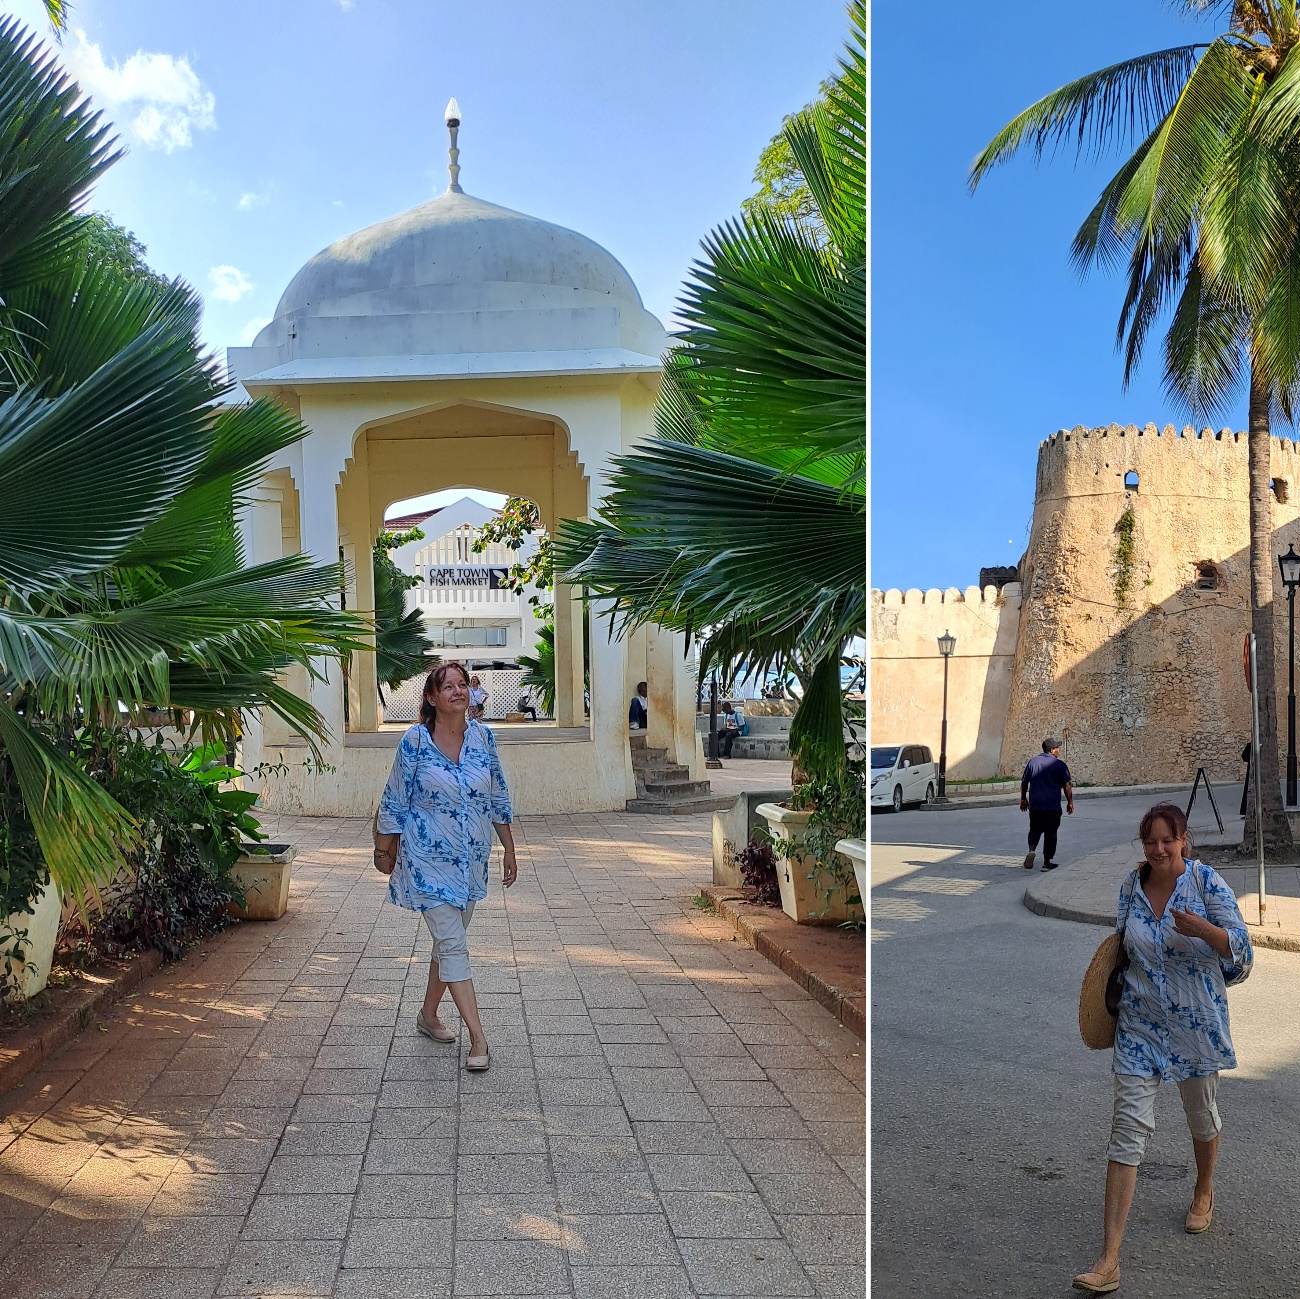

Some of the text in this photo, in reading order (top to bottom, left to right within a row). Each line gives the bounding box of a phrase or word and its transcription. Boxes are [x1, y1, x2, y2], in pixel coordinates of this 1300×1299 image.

[429, 568, 489, 578] CAPE TOWN
[430, 578, 489, 586] FISH MARKET
